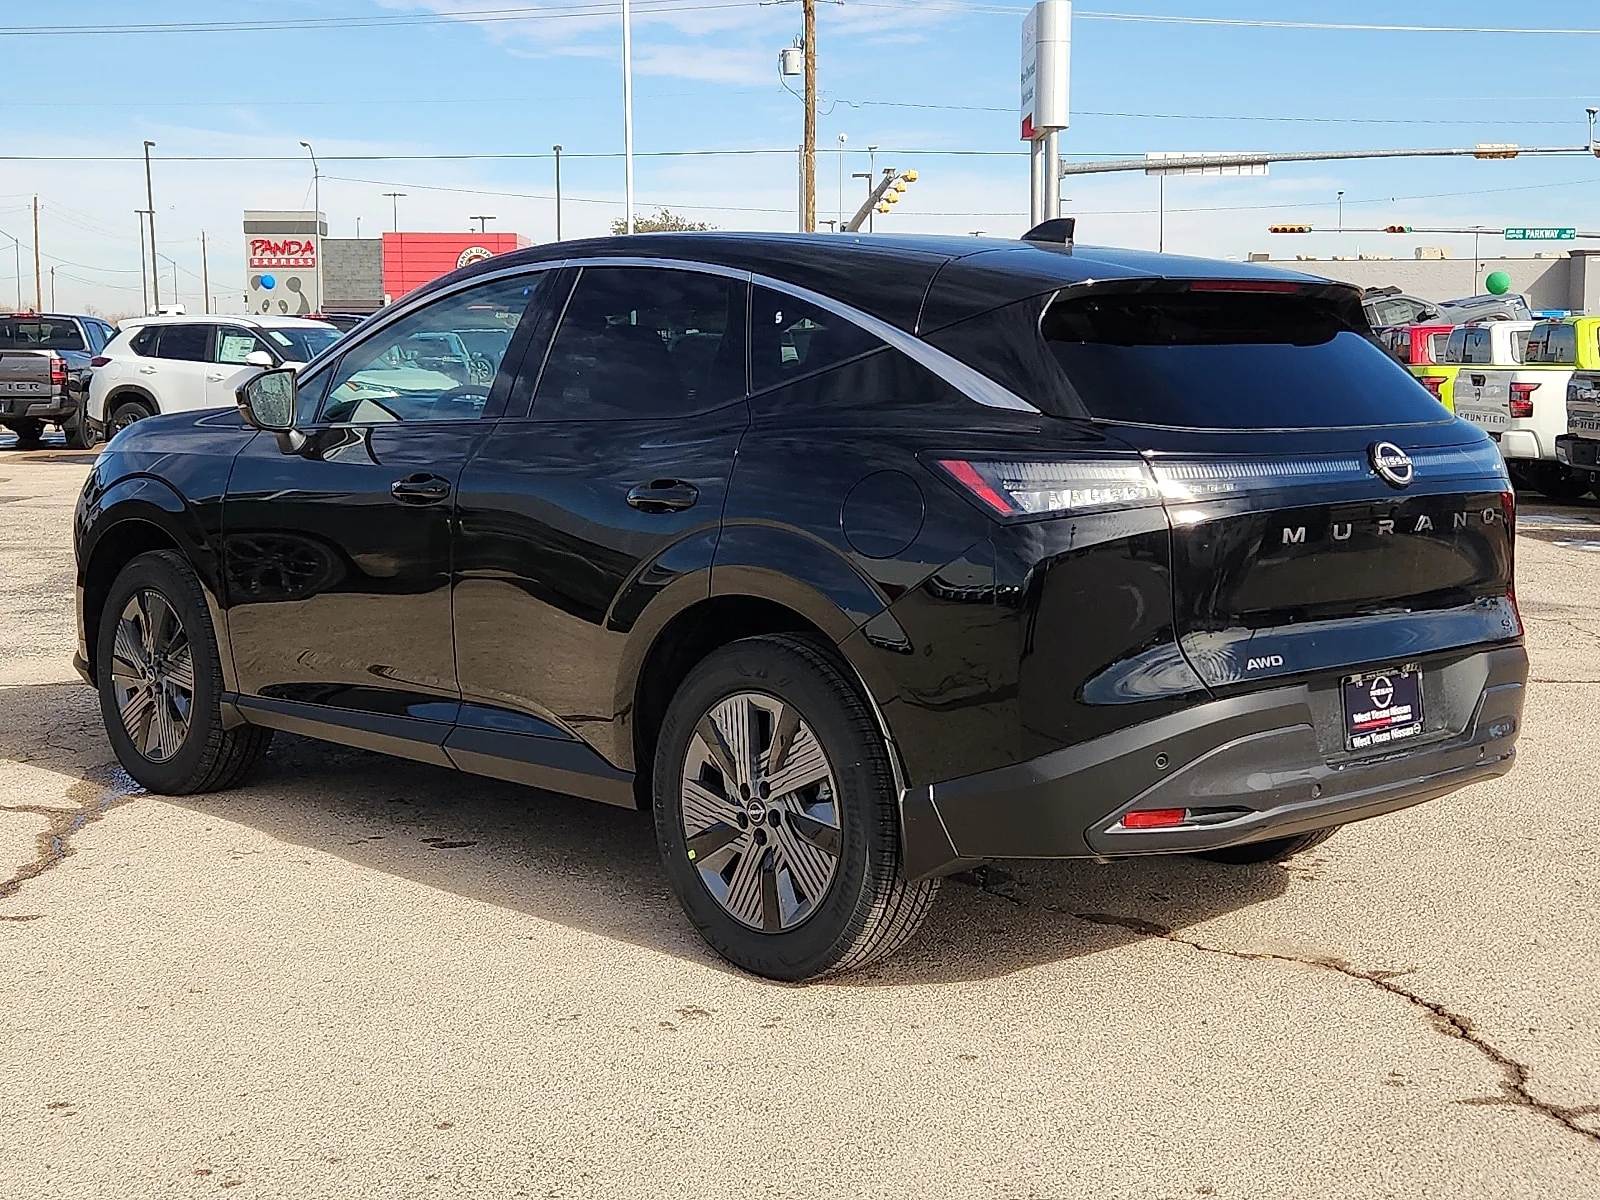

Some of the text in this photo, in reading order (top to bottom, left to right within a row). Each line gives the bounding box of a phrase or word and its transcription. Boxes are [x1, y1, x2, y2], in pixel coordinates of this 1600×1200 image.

[1525, 229, 1560, 239] PARKWAY
[250, 239, 314, 257] PANDA
[253, 258, 314, 266] EXPRESS
[459, 249, 474, 268] PANDA
[1459, 412, 1506, 424] FRONTIER
[1376, 456, 1413, 468] NISSAN
[1281, 507, 1498, 545] MURANO
[1246, 655, 1284, 671] AWD
[1353, 711, 1371, 723] West
[1371, 709, 1390, 719] Texas
[1390, 705, 1412, 716] Nissan
[1353, 727, 1414, 748] West Texas Nissan
